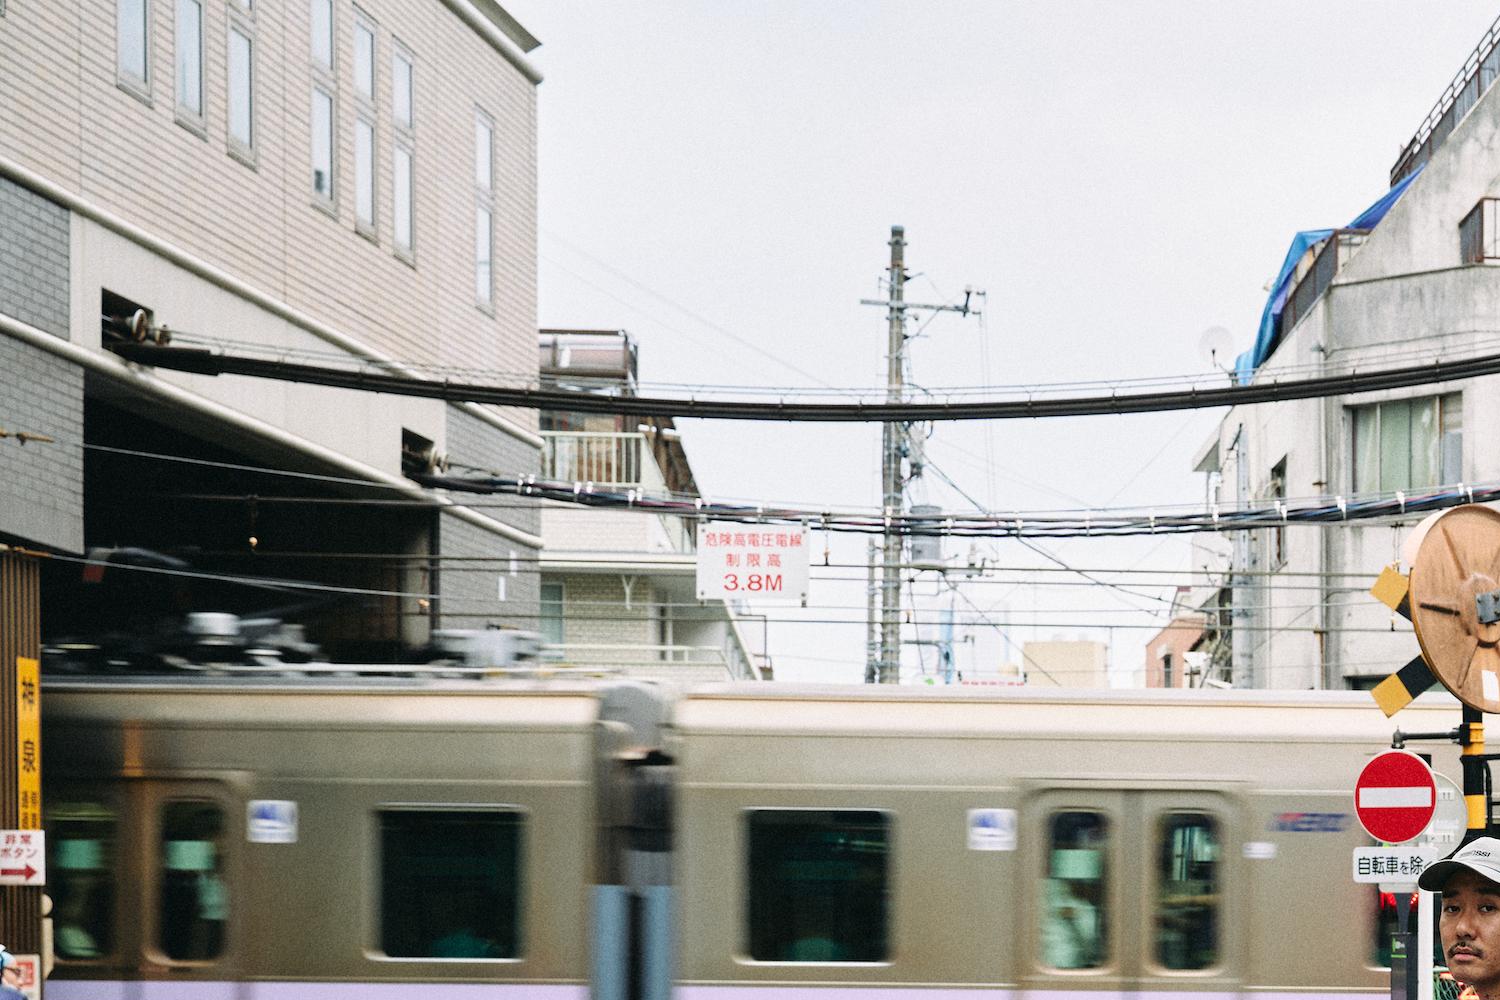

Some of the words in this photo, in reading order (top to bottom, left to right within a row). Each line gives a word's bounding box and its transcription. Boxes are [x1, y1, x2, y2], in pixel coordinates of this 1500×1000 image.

[705, 531, 802, 547] 危険高電圧電線
[726, 552, 781, 567] 制限高
[723, 573, 782, 592] 3.8M
[5, 834, 31, 844] 非常
[0, 848, 38, 858] ボタン
